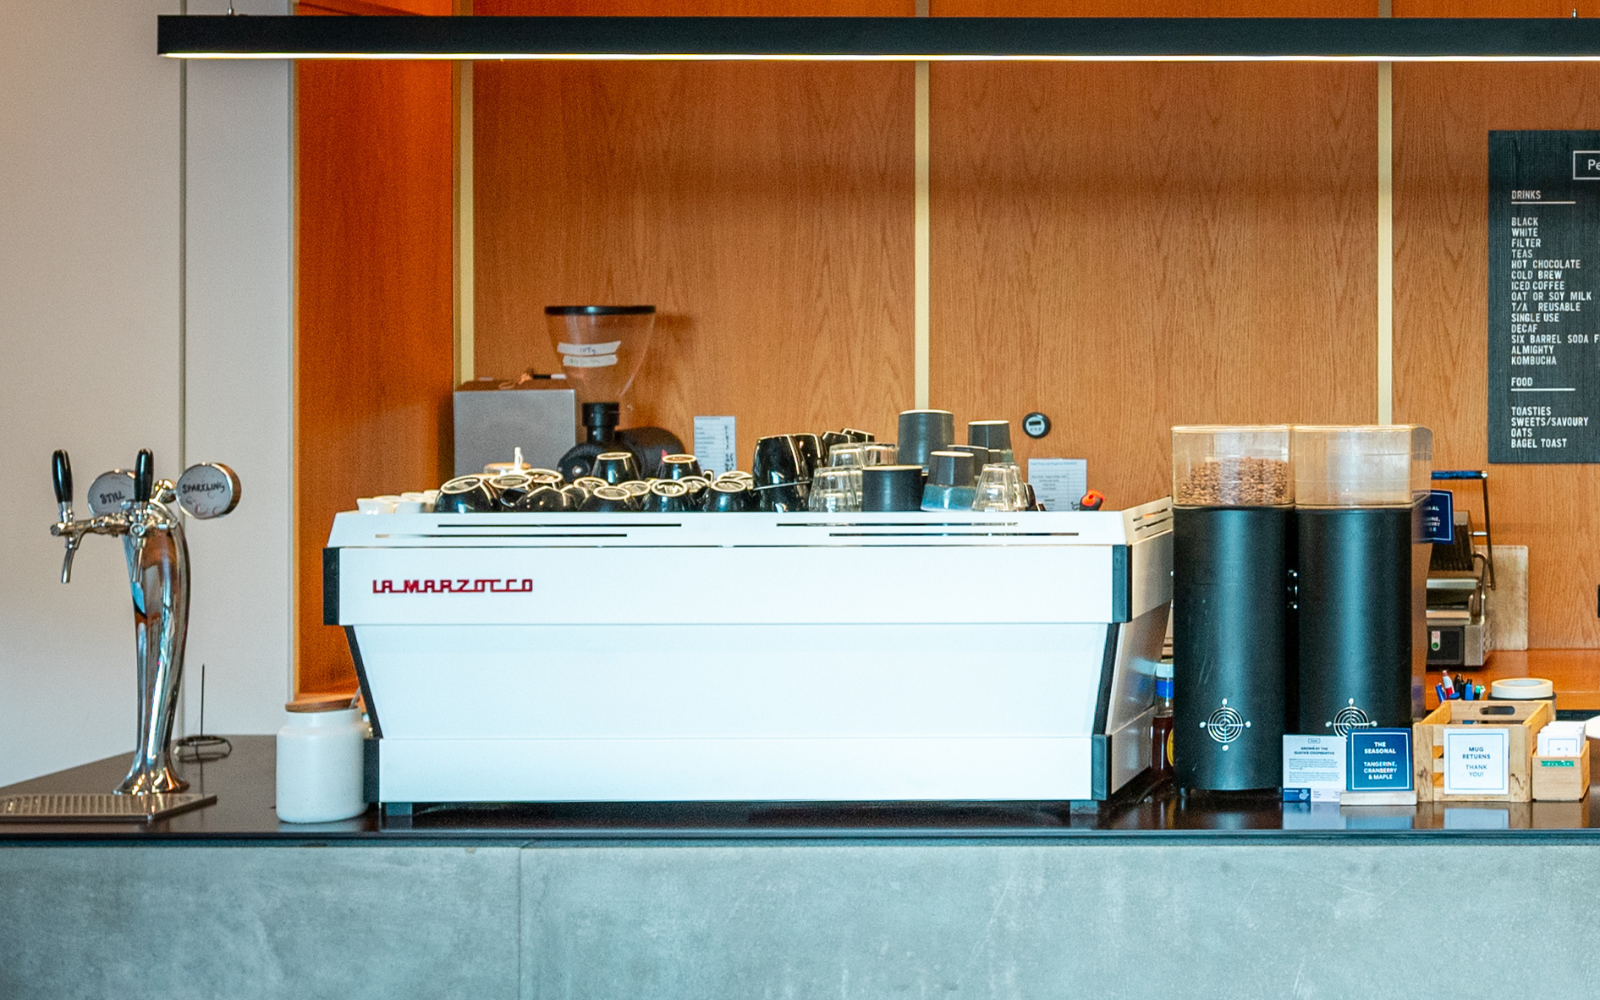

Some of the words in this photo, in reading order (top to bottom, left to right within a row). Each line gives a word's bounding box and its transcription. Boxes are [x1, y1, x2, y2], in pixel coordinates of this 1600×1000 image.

[1511, 190, 1541, 200] DRINKS
[1511, 217, 1539, 226] BLACK
[1511, 228, 1538, 237] WHITE
[1511, 238, 1541, 248] FILTER
[1512, 249, 1533, 258] TEAS
[1511, 260, 1527, 269] HOT
[1532, 260, 1581, 269] CHOCOLATE
[1511, 270, 1533, 280] COLD
[1538, 270, 1562, 280] BREW
[1511, 281, 1530, 290] ICED
[1532, 281, 1565, 290] COFFEE
[1511, 292, 1528, 301] OAT
[1533, 292, 1544, 301] OR
[1548, 292, 1565, 301] SOY
[1570, 292, 1592, 301] MILK
[1511, 302, 1528, 311] T/A
[1538, 302, 1581, 311] REUSABLE
[1511, 313, 1540, 322] SINGLE
[1544, 313, 1560, 322] USE
[1511, 324, 1538, 333] DECAF
[1511, 334, 1525, 344] SIX
[1530, 334, 1562, 344] BARREL
[1567, 334, 1589, 344] SODA
[1511, 345, 1554, 354] ALMIGHTY
[1511, 356, 1557, 365] KOMBUCHA
[1511, 377, 1533, 387] FOOD
[1511, 406, 1551, 416] TOASTIES
[1511, 417, 1588, 427] SWEETS/SAVOURY
[1511, 428, 1533, 437] OATS
[1511, 438, 1537, 448] BAGEL
[1541, 438, 1567, 448] TOAST
[182, 482, 226, 494] SPARKLING
[99, 491, 126, 504] STILL
[372, 579, 392, 593] LA
[404, 579, 533, 593] MARZOCCO
